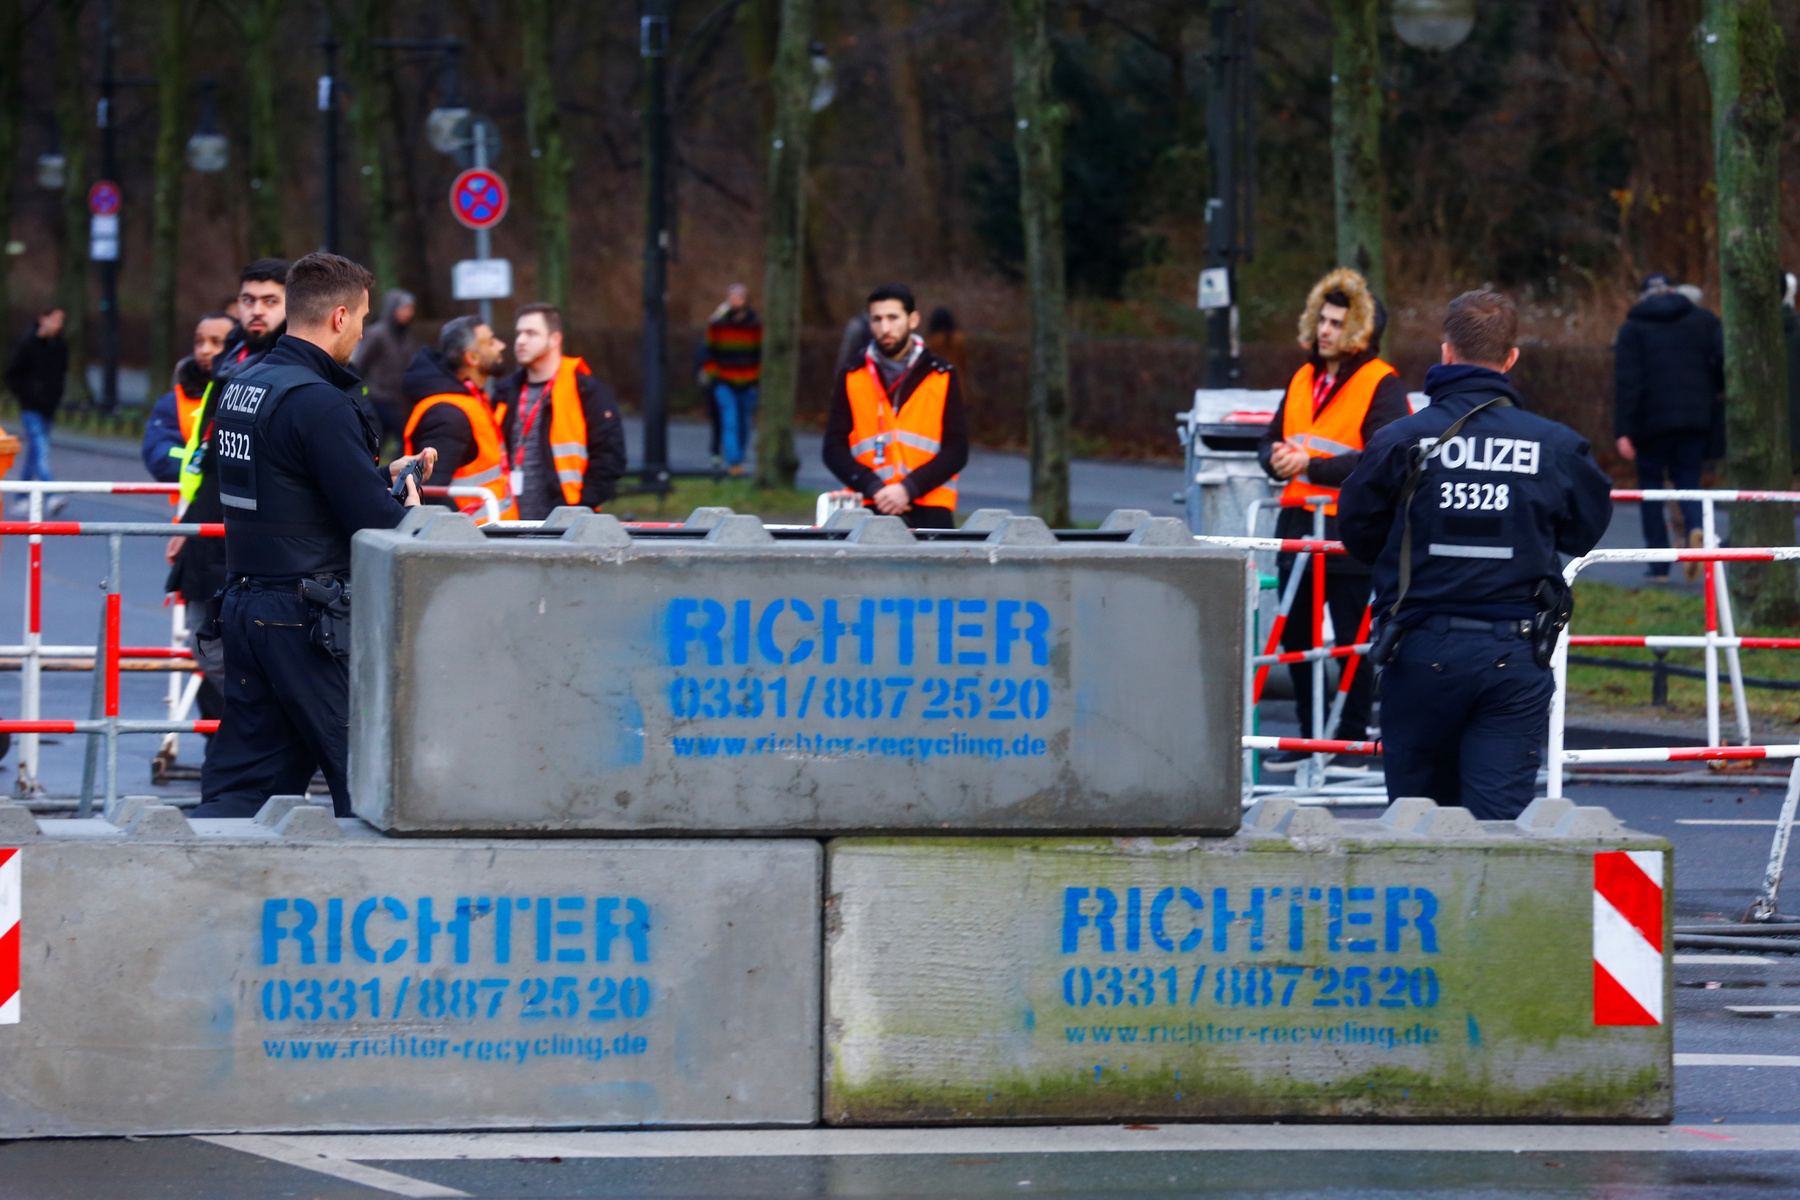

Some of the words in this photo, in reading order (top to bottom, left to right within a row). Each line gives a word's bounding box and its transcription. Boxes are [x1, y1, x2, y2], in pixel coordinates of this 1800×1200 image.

[220, 383, 267, 414] POLIZEI
[218, 429, 251, 461] 35322
[1419, 435, 1541, 475] POLIZEI
[1439, 481, 1510, 511] 35328
[668, 597, 1052, 666] RICHTER
[672, 732, 1047, 761] www.richter-recycling.de
[261, 896, 651, 966] RICHTER
[1061, 886, 1440, 954] RICHTER
[263, 1032, 648, 1066] www.richter-recycling.de
